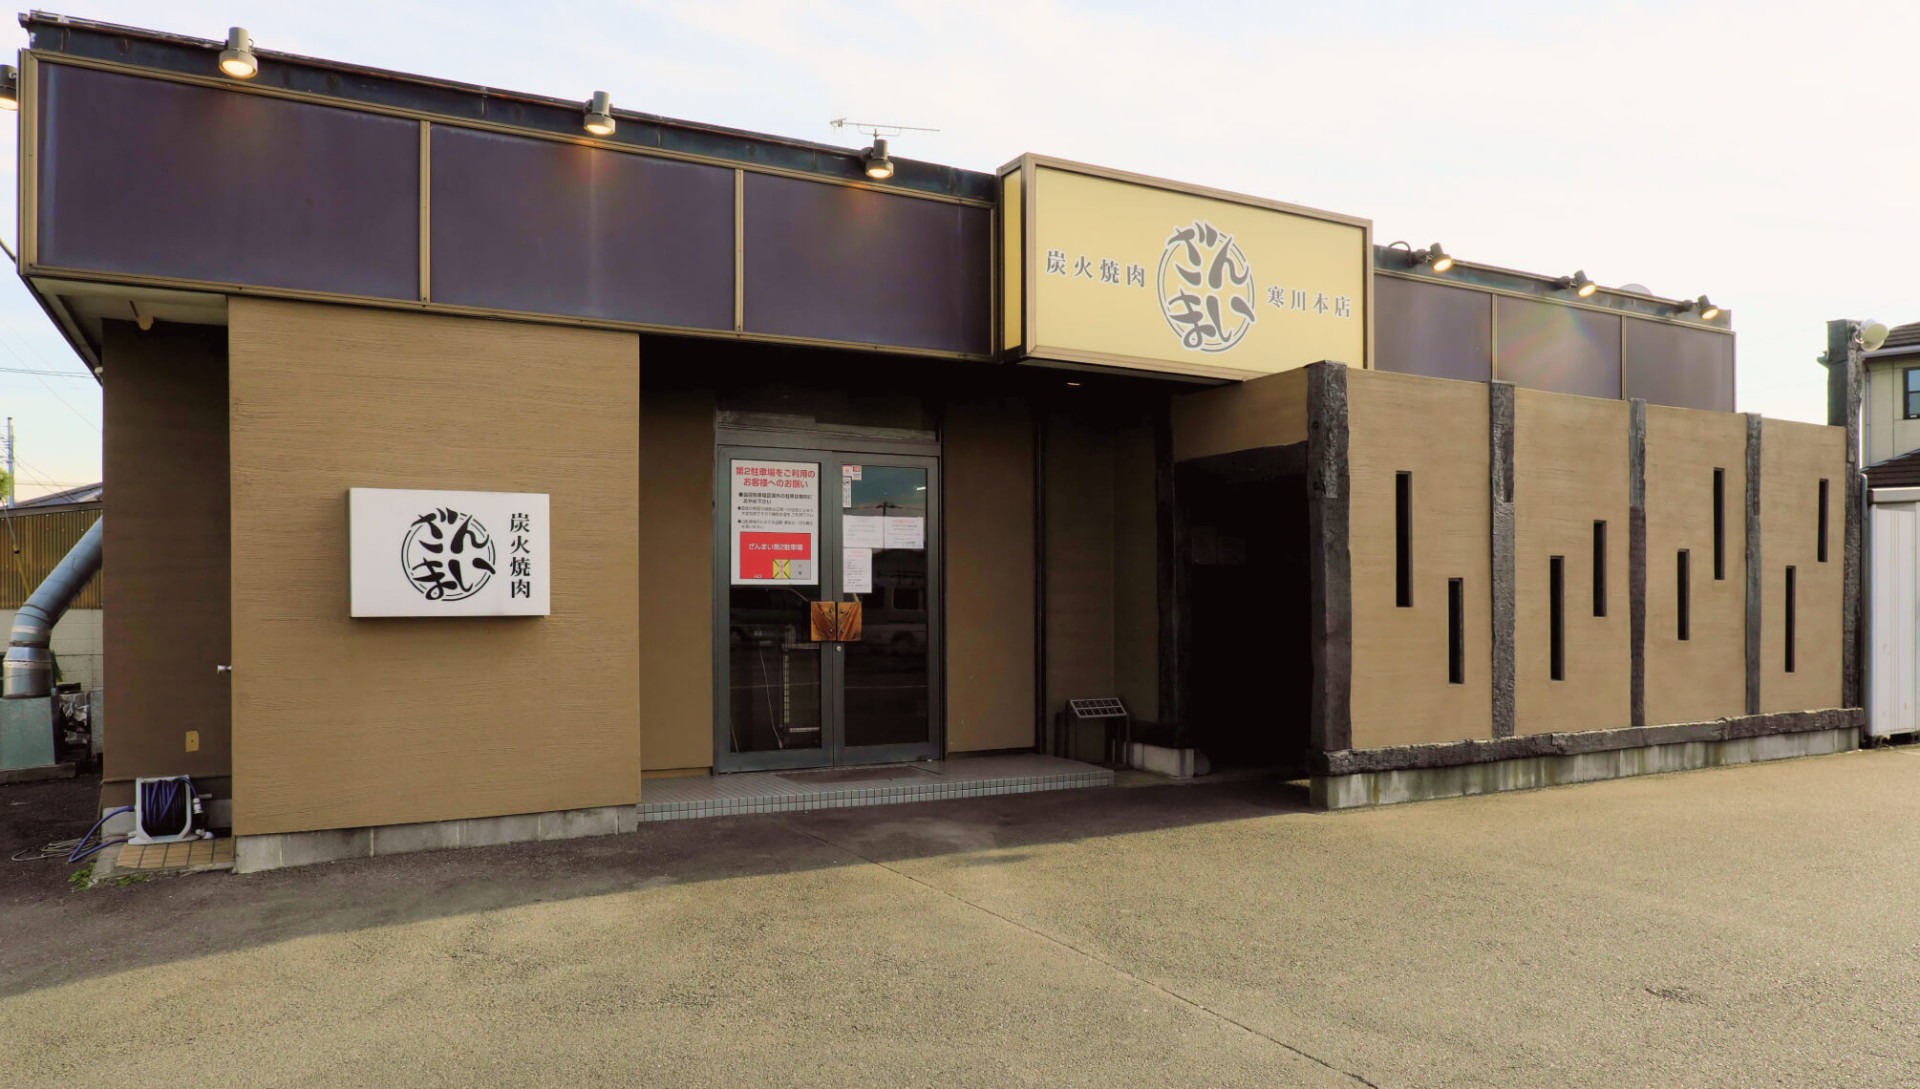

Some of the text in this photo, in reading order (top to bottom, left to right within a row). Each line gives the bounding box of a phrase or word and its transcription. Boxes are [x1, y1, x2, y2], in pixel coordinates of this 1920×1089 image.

[1046, 250, 1146, 288] 炭火焼肉
[1266, 285, 1351, 318] 寒川本店
[735, 466, 816, 479] 第2駐車場をご利用の
[743, 478, 808, 489] お客様へのお願い
[509, 512, 531, 599] 炭火焼肉
